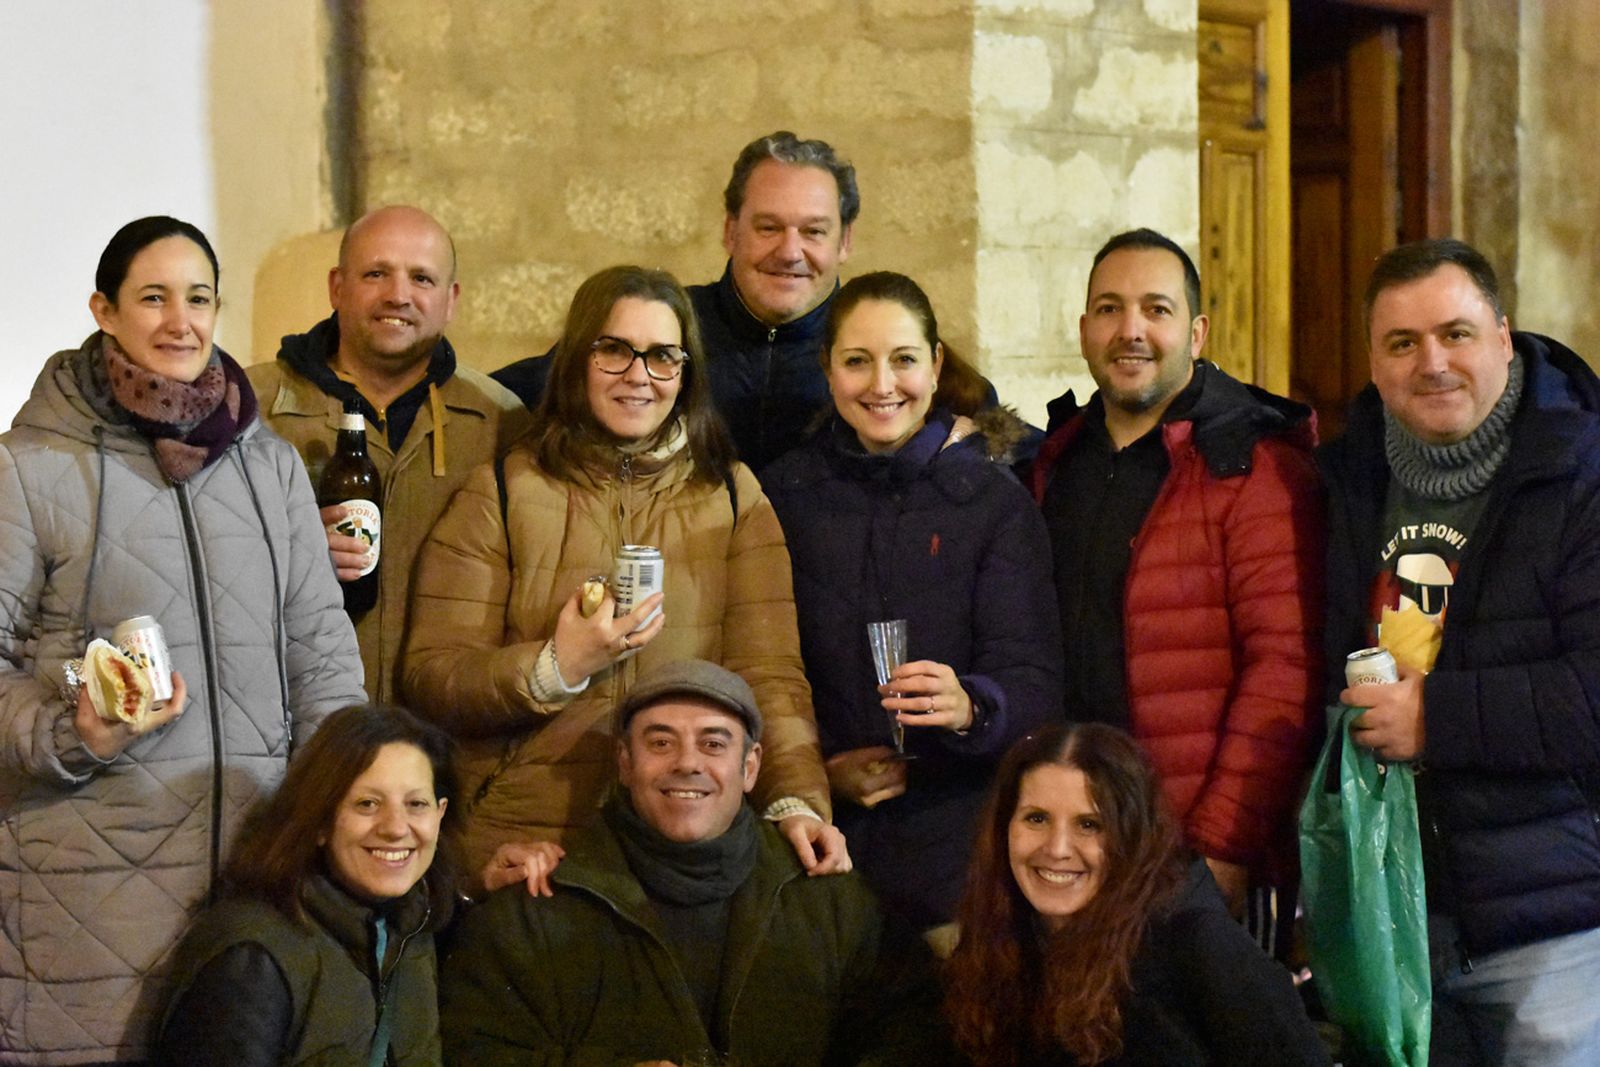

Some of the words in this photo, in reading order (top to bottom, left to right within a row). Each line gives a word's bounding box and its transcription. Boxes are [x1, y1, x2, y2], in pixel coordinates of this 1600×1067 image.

[348, 507, 378, 526] TORIA
[1401, 525, 1419, 540] IT
[1422, 522, 1468, 551] SNOW!
